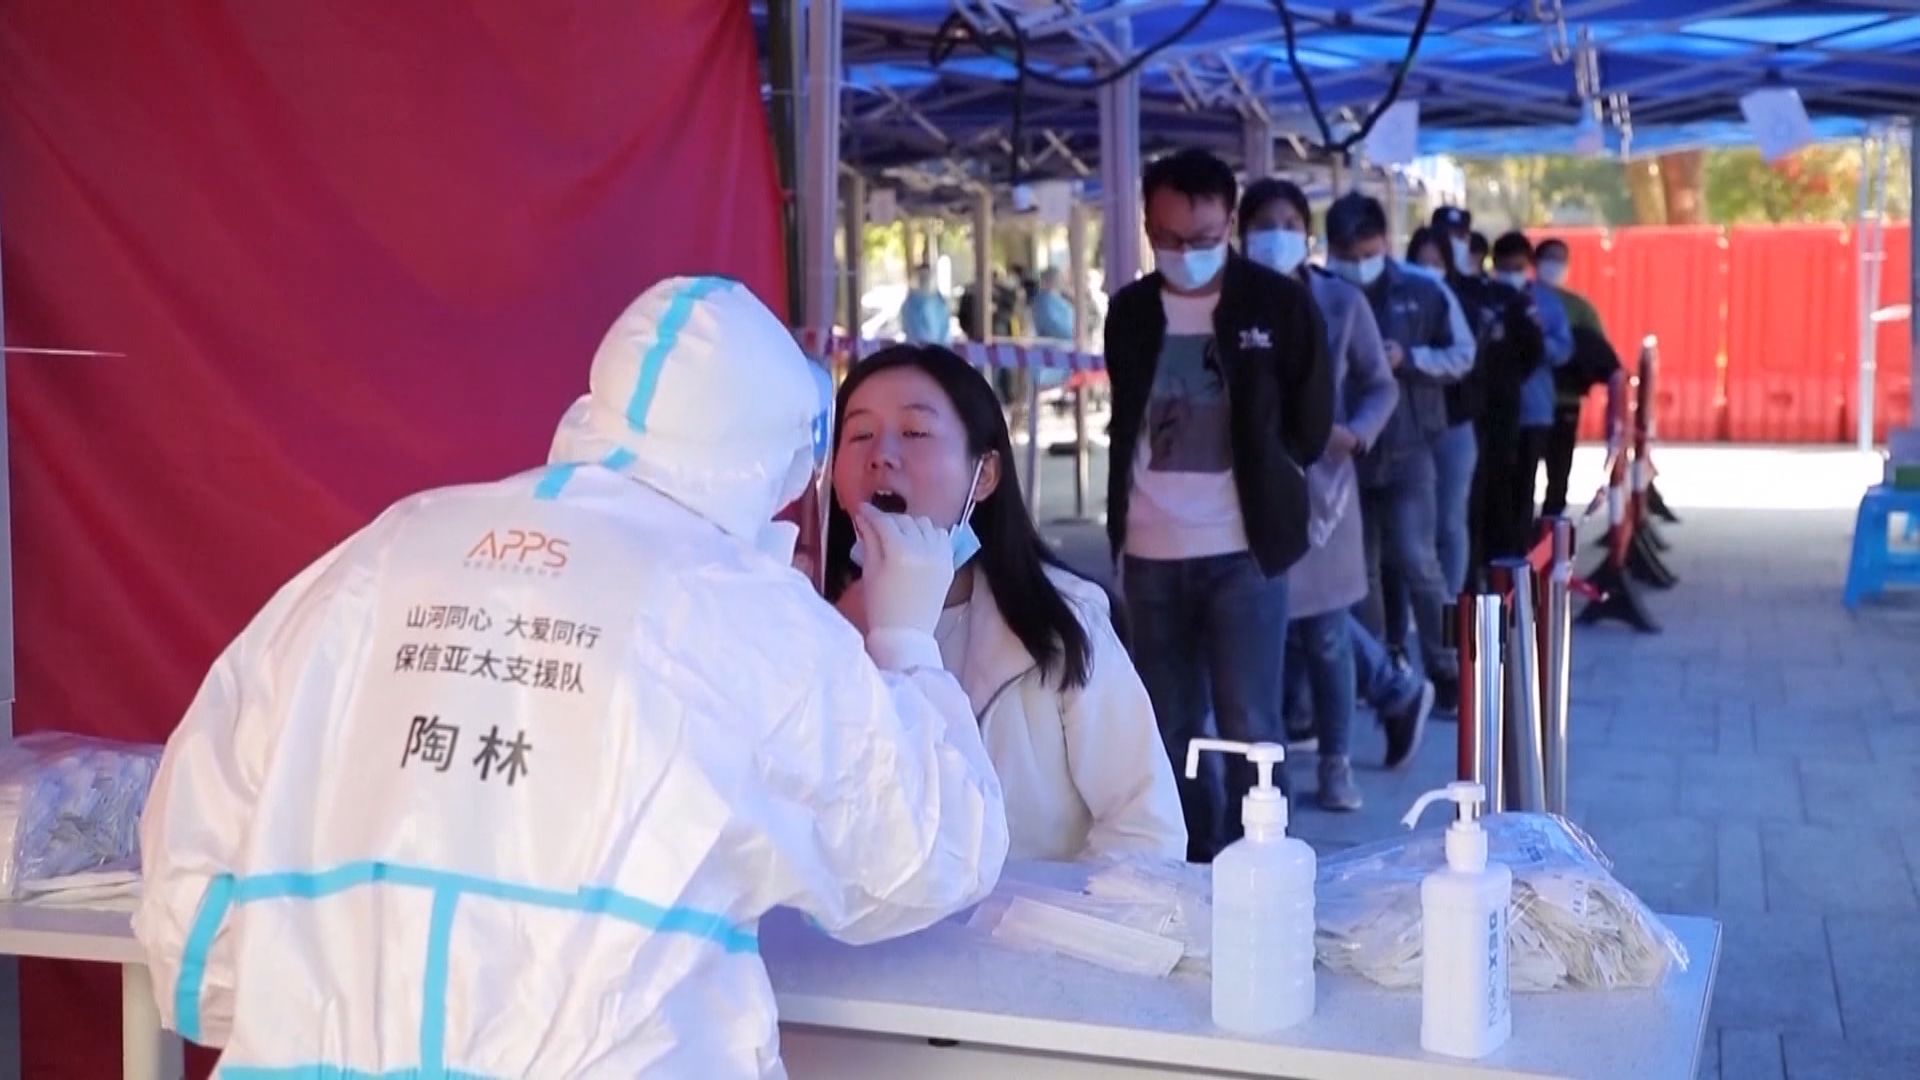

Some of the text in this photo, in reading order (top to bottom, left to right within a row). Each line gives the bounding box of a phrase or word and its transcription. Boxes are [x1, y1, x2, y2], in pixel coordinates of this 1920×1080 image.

[467, 530, 570, 568] APPS
[407, 605, 602, 649] 山河同心 大爱同行
[394, 643, 584, 693] 保信亚太支援队
